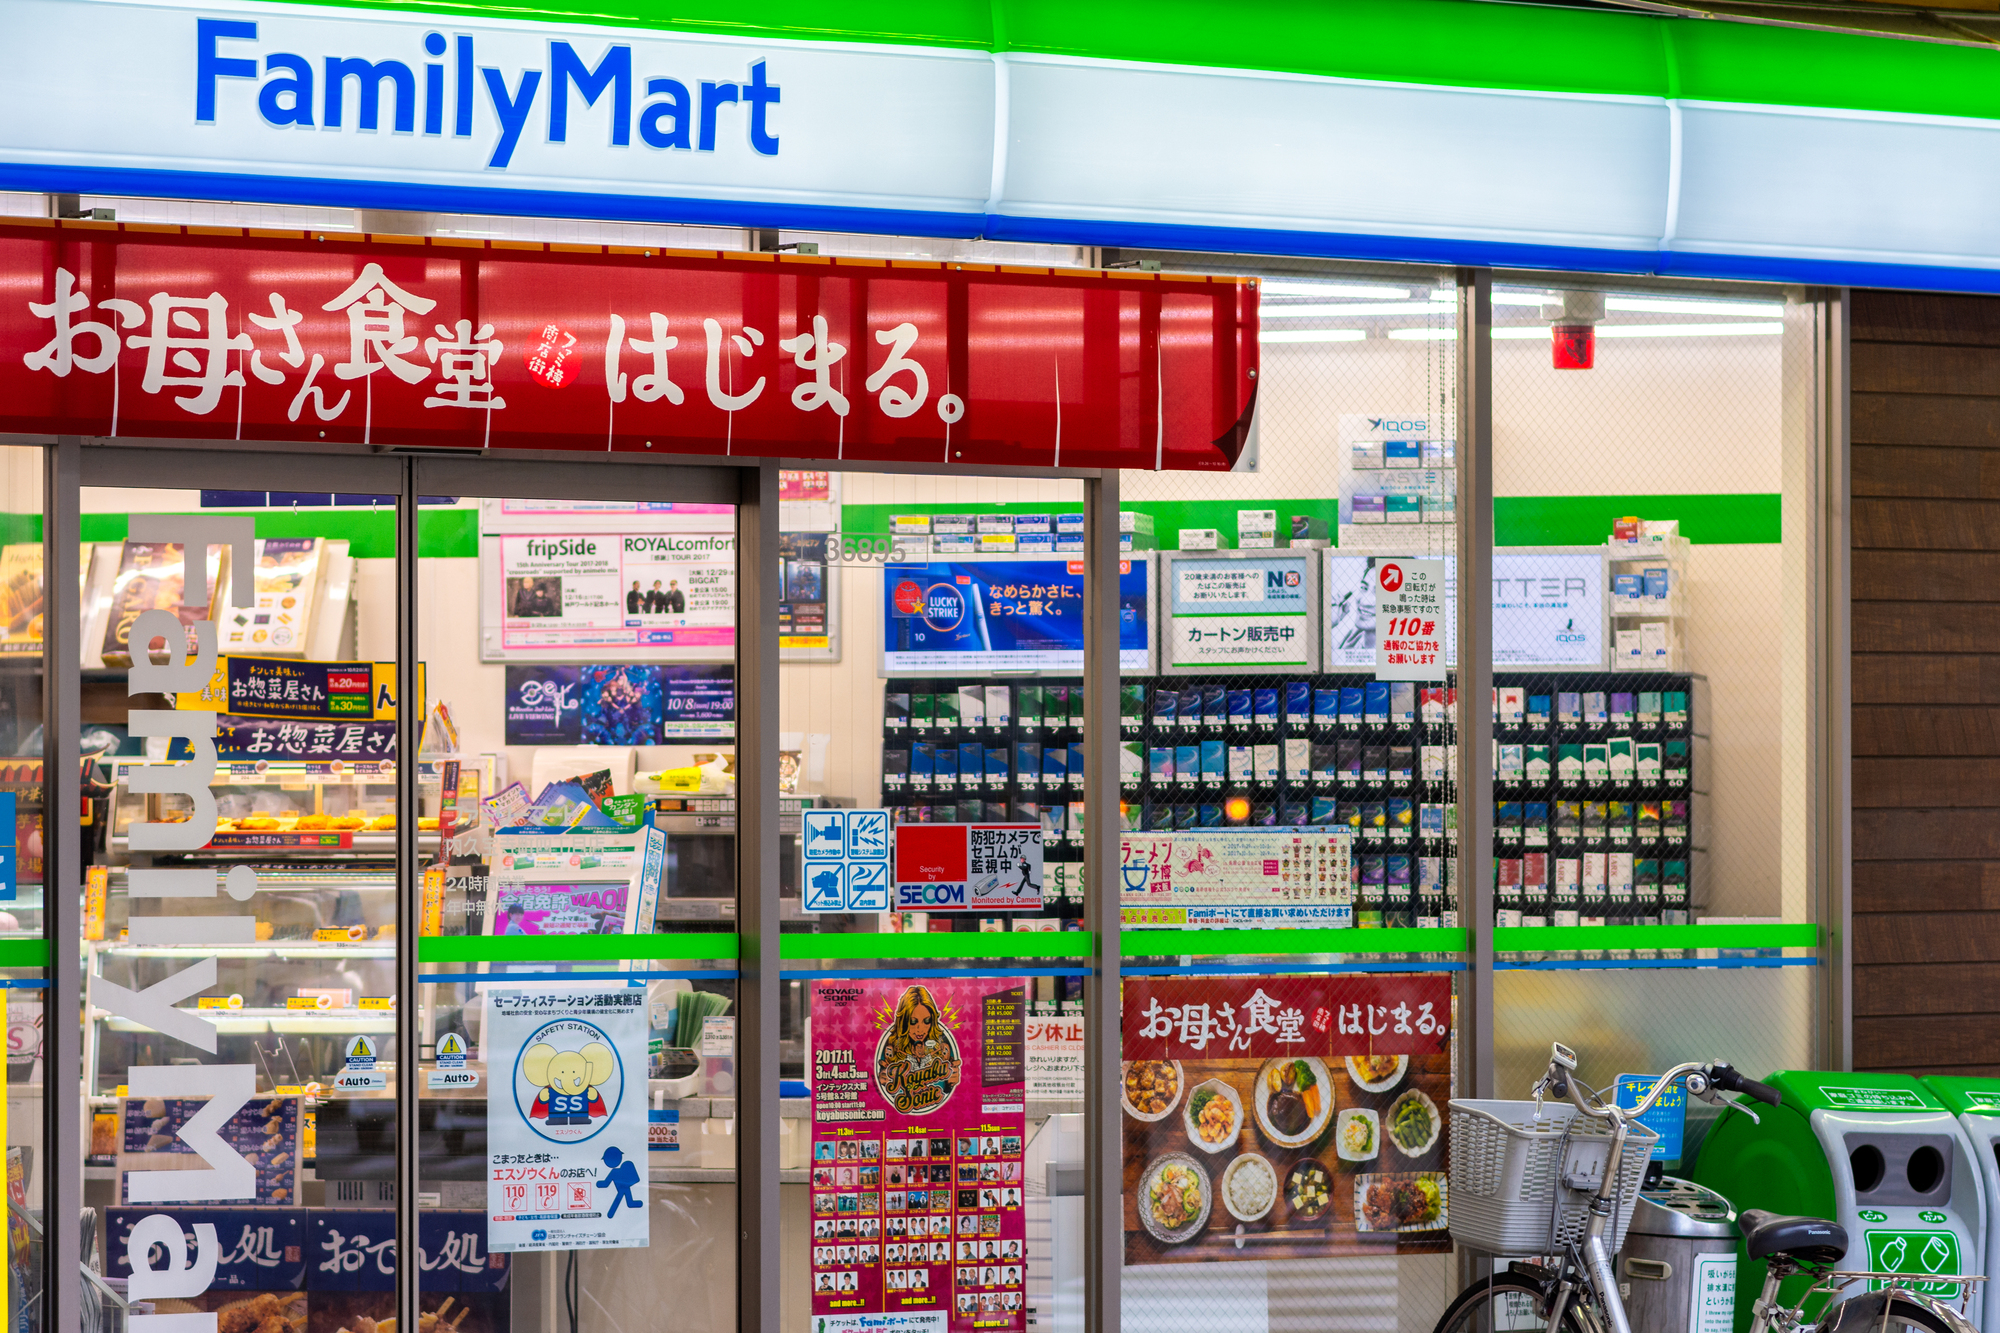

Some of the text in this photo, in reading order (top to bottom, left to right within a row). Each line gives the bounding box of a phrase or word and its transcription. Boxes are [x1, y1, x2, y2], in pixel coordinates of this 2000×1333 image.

[196, 18, 781, 169] FamilyMart
[24, 263, 965, 424] お母さん食堂 はじまる。
[527, 539, 597, 560] fripSide
[824, 538, 906, 563] 36895
[1411, 572, 1427, 581] この
[989, 585, 1083, 599] なめらかさに、
[1404, 583, 1436, 592] 回転灯が
[930, 597, 958, 608] LUCKY
[1399, 593, 1436, 603] 鳴った時は
[928, 608, 959, 618] STRIKE
[989, 601, 1063, 616] きっと驚く。
[1382, 604, 1440, 614] 緊急事態ですので
[1388, 617, 1435, 636] 110番
[1189, 626, 1295, 642] カートン販売中
[1383, 640, 1440, 652] 通報のご協力を
[1388, 653, 1436, 665] お願いします
[250, 666, 305, 677] チンして美味しい
[231, 677, 325, 701] お惣菜屋さん
[893, 727, 899, 735] 1
[943, 727, 951, 735] 3
[994, 727, 1001, 735] 5
[1051, 727, 1059, 735] 7
[1292, 723, 1306, 731] 16
[1370, 723, 1384, 731] 19
[1505, 723, 1519, 731] 24
[1563, 723, 1577, 731] 26
[1615, 723, 1630, 731] 28
[914, 783, 928, 791] 32
[964, 783, 979, 791] 34
[1021, 783, 1035, 791] 36
[1206, 781, 1221, 789] 43
[1563, 780, 1577, 788] 56
[446, 804, 580, 827] ファミリーマート
[971, 830, 1041, 846] 防犯カメラで
[971, 845, 1022, 859] セコムが
[1120, 842, 1172, 864] ラーメン
[919, 865, 945, 874] Security
[971, 859, 1012, 874] 監視中
[928, 873, 936, 881] by
[446, 876, 526, 893] 24時間営業
[900, 884, 964, 904] SECOM
[971, 896, 1042, 905] Monitored by Camera
[446, 900, 506, 917] 年中無休
[1188, 908, 1351, 918] Famiポートにて直接お買い求めいただけます
[818, 988, 864, 996] KOYABU
[494, 994, 643, 1008] セーフティステーション活動実施店
[1138, 988, 1446, 1052] お母さん食堂 はじまる。
[535, 1023, 601, 1042] SAFETY STATION
[816, 1049, 855, 1065] 2017.11.
[444, 1074, 469, 1083] Auto
[886, 1058, 951, 1093] Koyabu
[345, 1077, 371, 1086] Auto
[816, 1082, 868, 1092] インテックス大阪
[816, 1091, 859, 1101] 5号館&2号館
[894, 1087, 941, 1113] Sonic
[1635, 1095, 1685, 1107] 守ましょう!
[554, 1096, 583, 1112] SS
[816, 1109, 885, 1123] koyabusonic.com
[908, 1126, 928, 1135] 11.4sat
[980, 1124, 1001, 1133] 11.5sun
[493, 1167, 598, 1181] エスゾウくんのお店へ!
[506, 1186, 525, 1198] 110
[538, 1185, 557, 1197] 119
[829, 1299, 841, 1308] and
[901, 1297, 913, 1305] and
[1598, 1291, 1614, 1329] Panasonic
[973, 1319, 985, 1328] and
